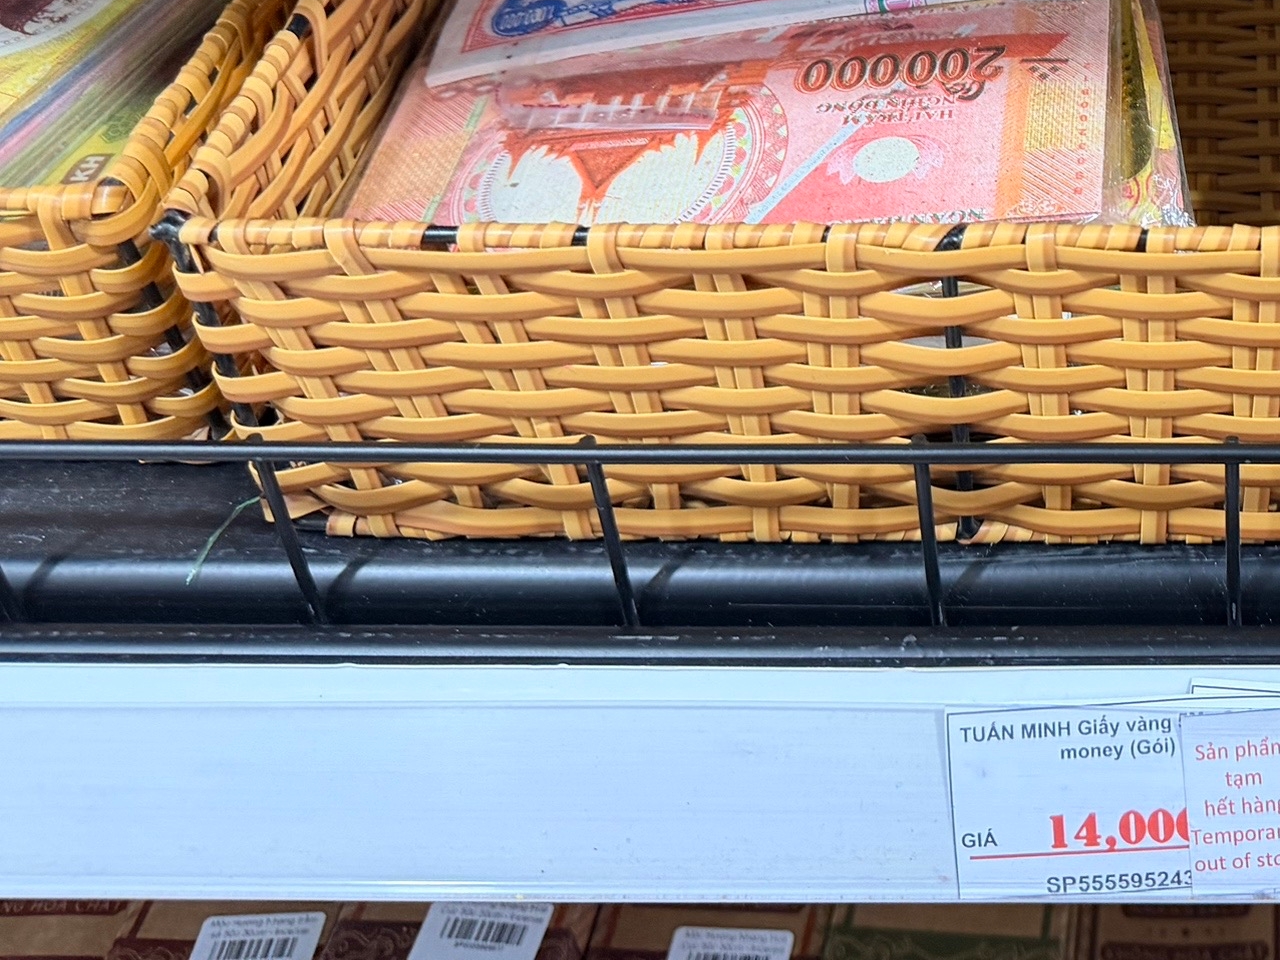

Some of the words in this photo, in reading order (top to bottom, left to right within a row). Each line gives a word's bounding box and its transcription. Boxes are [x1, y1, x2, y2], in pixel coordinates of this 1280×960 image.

[795, 44, 1009, 94] 200000
[1022, 721, 1071, 739] MINH
[1078, 715, 1120, 737] Giấy
[1126, 716, 1172, 734] vàng
[1060, 743, 1125, 760] money
[1130, 738, 1176, 759] (Gói)
[1195, 741, 1229, 761] Sản
[1225, 771, 1263, 789] tạm
[1204, 796, 1236, 817] hết
[962, 828, 999, 848] GIÁ
[1195, 855, 1227, 872] out
[1232, 851, 1251, 869] of
